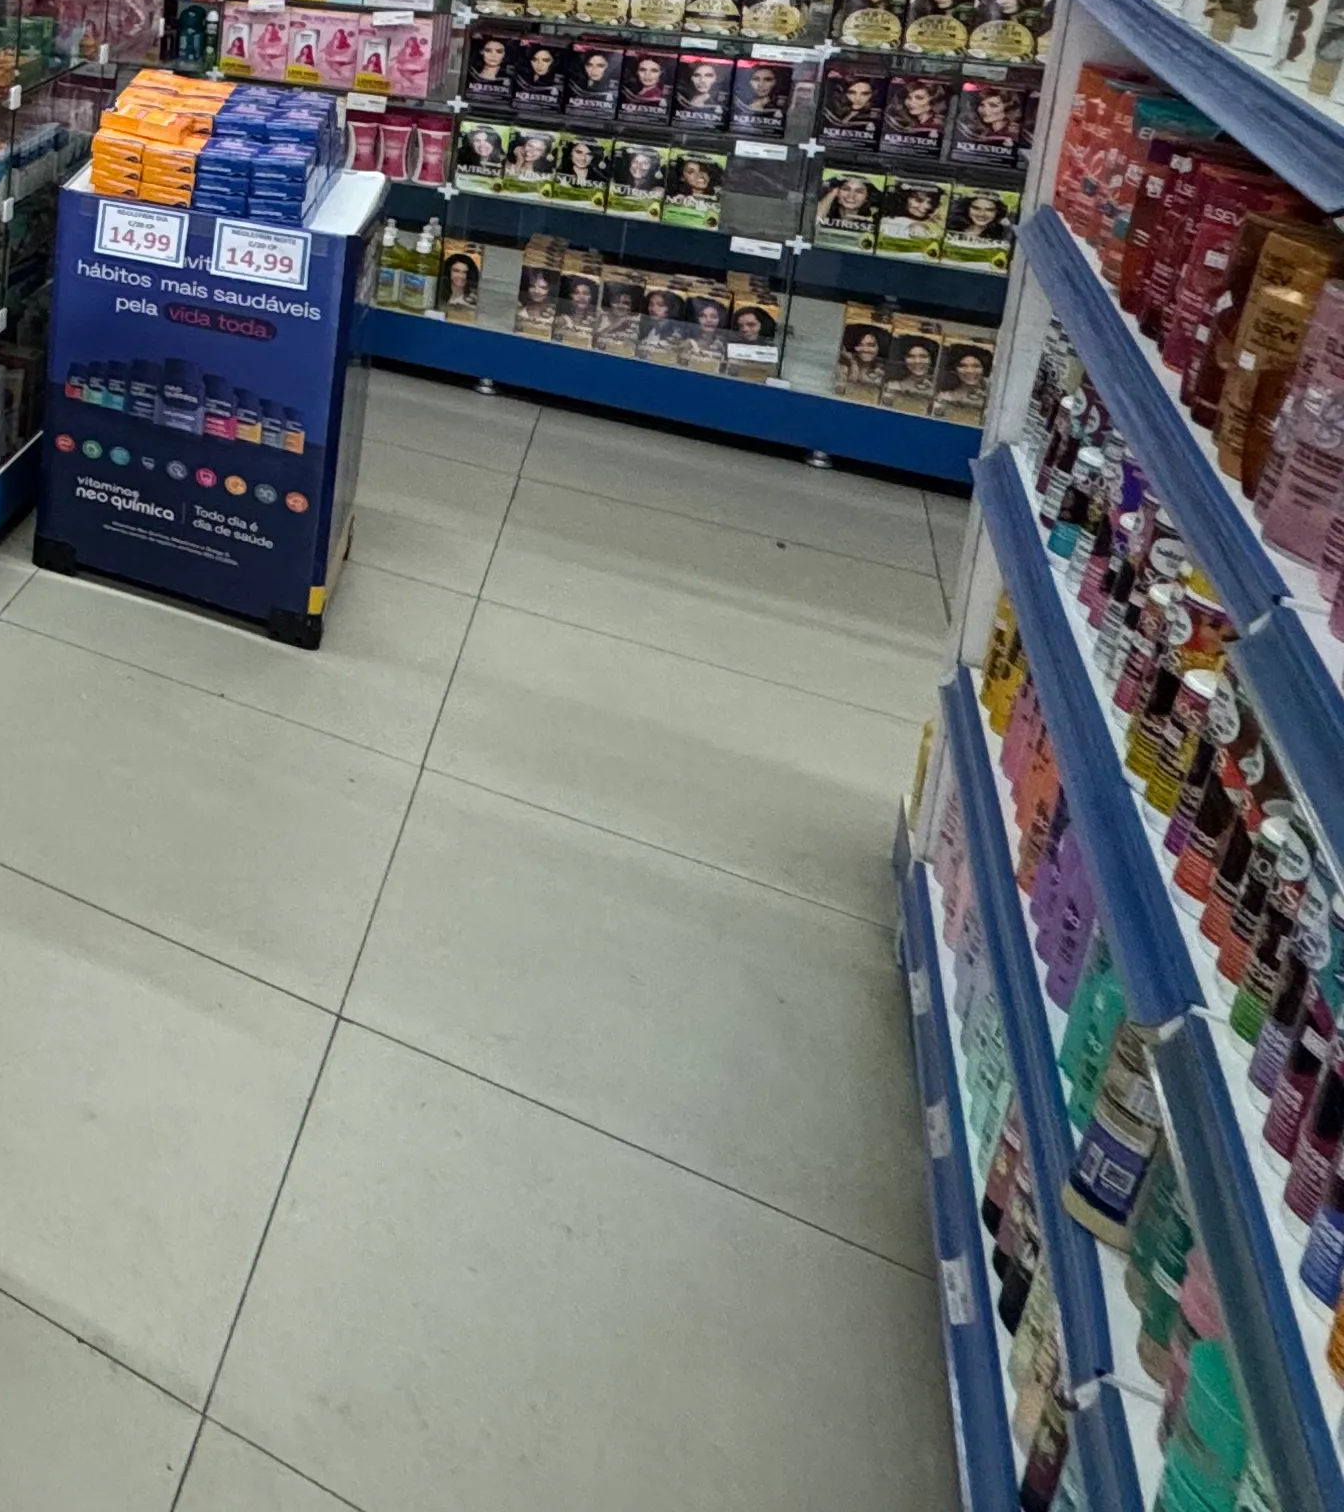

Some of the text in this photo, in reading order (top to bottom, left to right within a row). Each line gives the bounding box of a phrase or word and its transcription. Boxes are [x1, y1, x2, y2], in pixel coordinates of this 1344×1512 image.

[621, 103, 667, 115] KOLESTON
[816, 216, 876, 233] NUTRISSE
[109, 226, 171, 252] 14,99
[226, 247, 293, 274] 14,99
[77, 259, 321, 321] hábitos mais saudáveis
[116, 295, 272, 340] pela vida toda.
[76, 476, 140, 500] vitaminas
[75, 486, 175, 521] neo química
[194, 505, 247, 529] Todo dia
[193, 519, 274, 550] dia de saúde
